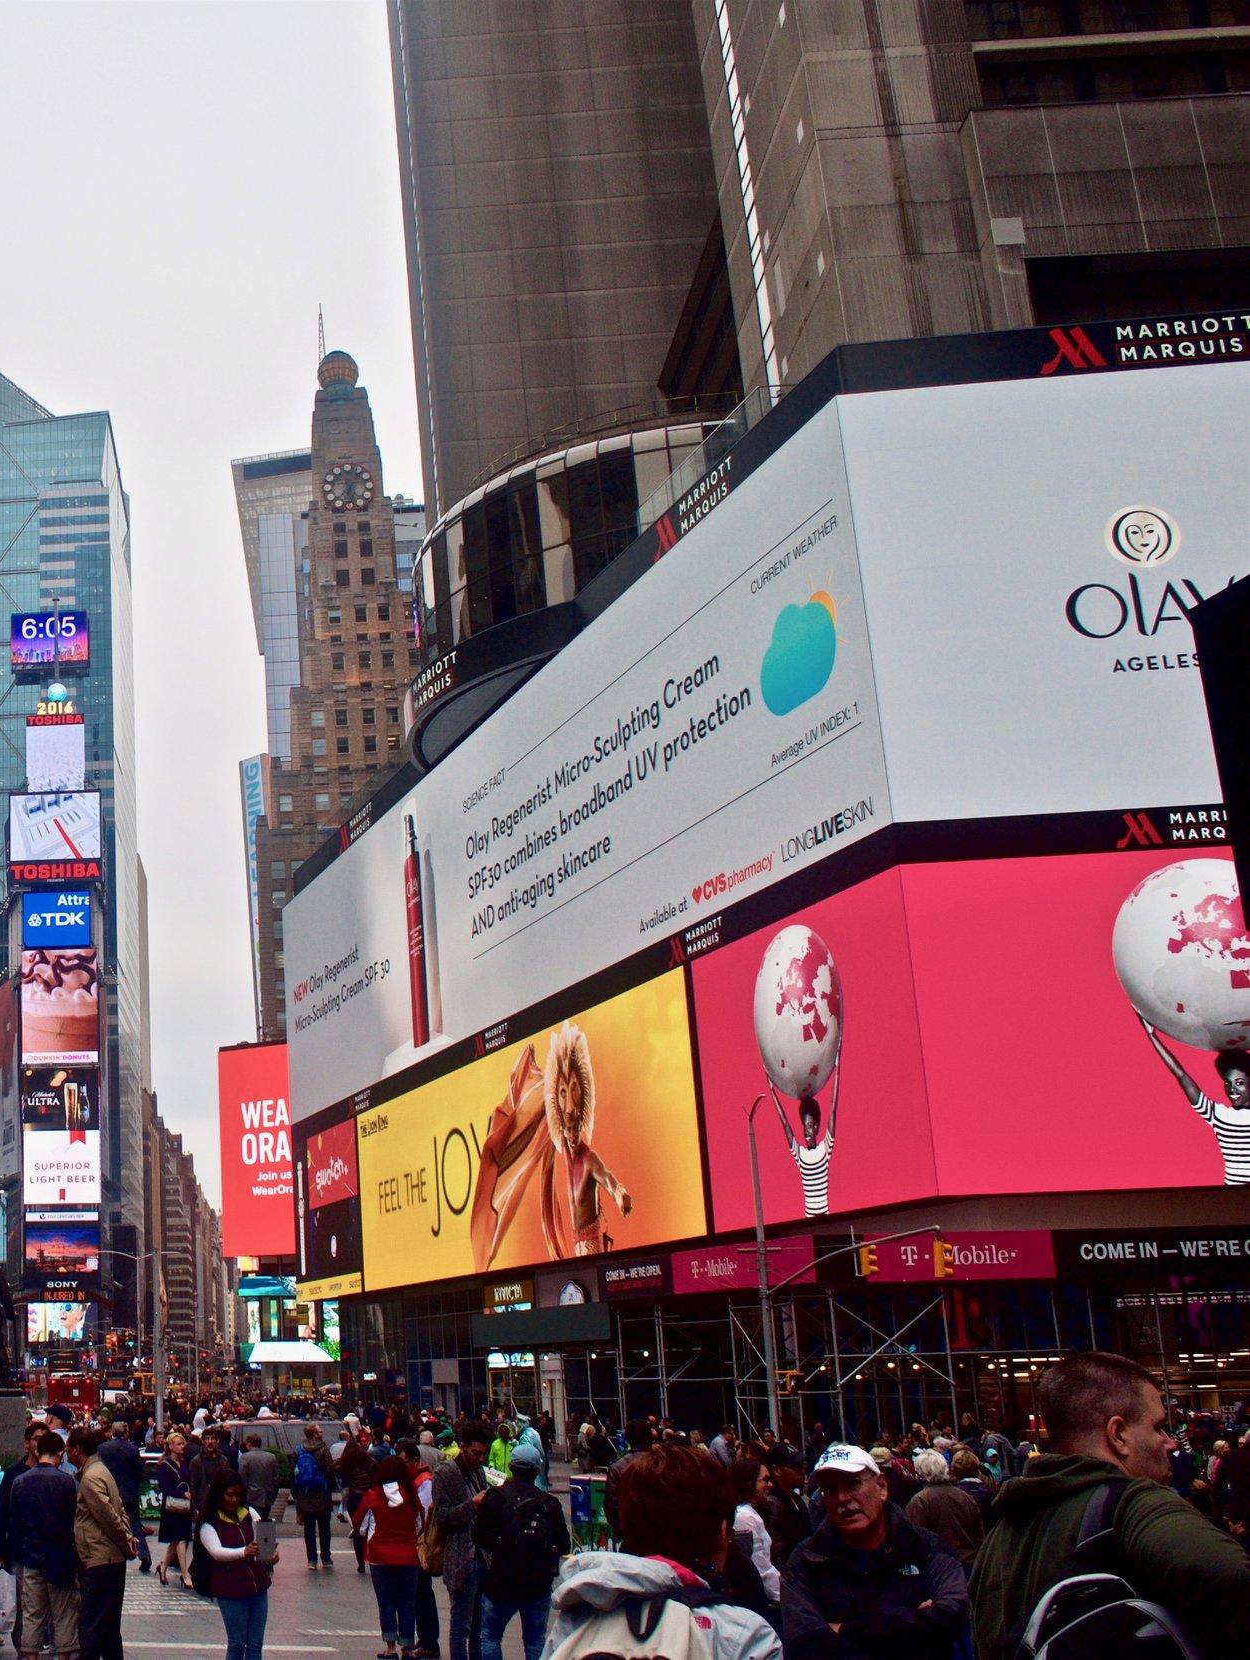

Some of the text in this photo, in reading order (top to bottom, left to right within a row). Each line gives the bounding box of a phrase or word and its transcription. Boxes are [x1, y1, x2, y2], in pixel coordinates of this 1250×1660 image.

[1116, 315, 1250, 340] MARRIOTT
[1120, 337, 1243, 361] MARQUIS
[678, 456, 733, 516] MARRIOTT
[680, 481, 728, 534] MARQUIS
[750, 515, 838, 594] CURRENT WEATHER
[21, 616, 77, 640] 6:05
[411, 651, 456, 695] MARRIOTT
[27, 715, 83, 725] TOSHIBA
[37, 701, 73, 715] 2016
[465, 655, 720, 859] Olay Regenerist Micro-Sculpting Cream
[771, 737, 805, 768] Average
[804, 729, 818, 746] UV
[462, 768, 506, 814] SCIENCE FACT
[468, 687, 751, 900] SPF30 combines broadband UV protection
[11, 862, 99, 880] TOSHIBA
[639, 796, 874, 934] Available at CVS pharmacy LONGLIVESKIN
[471, 835, 611, 939] AND anti-aging skincare
[41, 912, 85, 926] TDK
[685, 916, 723, 942] MARRIOTT
[686, 932, 720, 955] MARQUIS
[293, 944, 360, 1005] NEW Olay Regenerist
[295, 958, 390, 1034] Micro-Sculpting Cream SPF 30
[34, 1162, 90, 1170] SUPERIOR
[256, 1170, 292, 1182] Join us
[378, 1174, 402, 1214] FEEL
[404, 1167, 427, 1207] THE
[1080, 1243, 1136, 1260] COME
[1139, 1242, 1158, 1258] IN
[44, 1291, 85, 1300] INJURED IN
